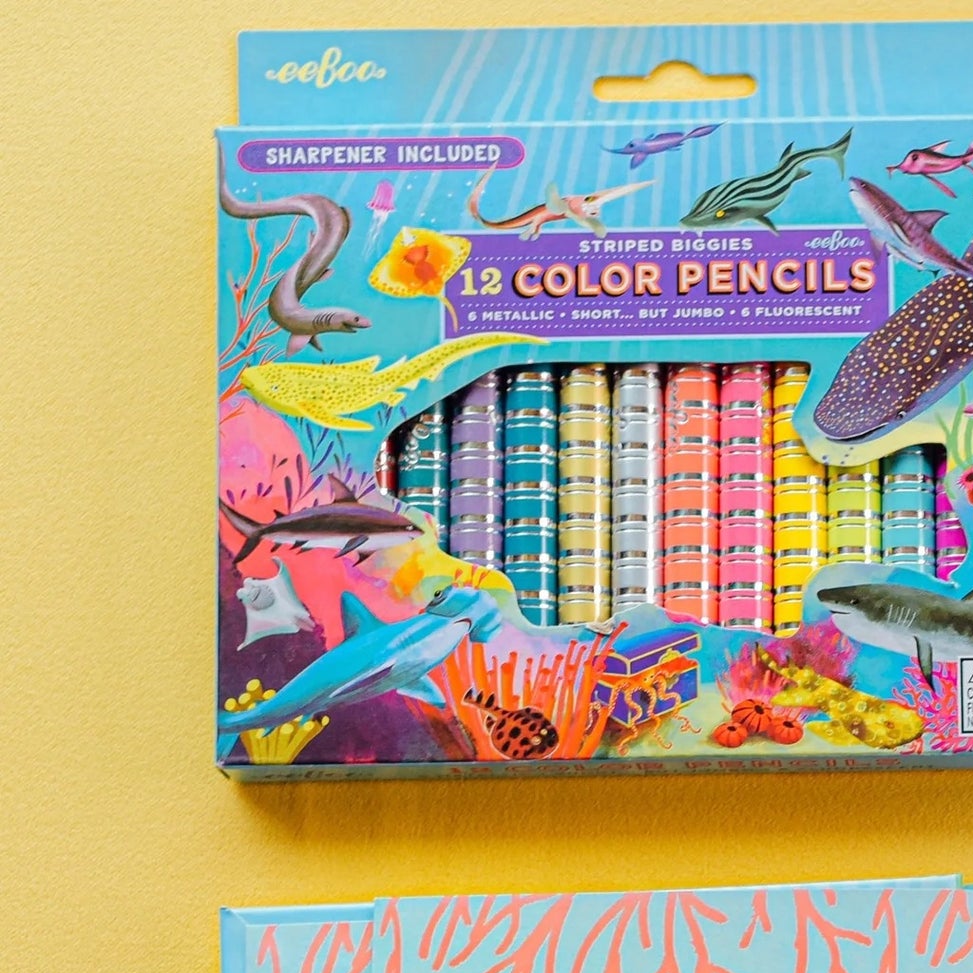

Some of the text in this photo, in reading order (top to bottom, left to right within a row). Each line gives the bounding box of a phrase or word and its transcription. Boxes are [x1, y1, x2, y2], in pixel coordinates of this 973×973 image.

[266, 144, 501, 165] SHARPENER INCLUDED
[579, 238, 753, 253] STRIPED BIGGIES
[459, 258, 877, 298] 12 COLOR PENCILS
[467, 305, 862, 322] 6 METALLIC SHORT... BUT JUMBO 6 FLUORESCENT
